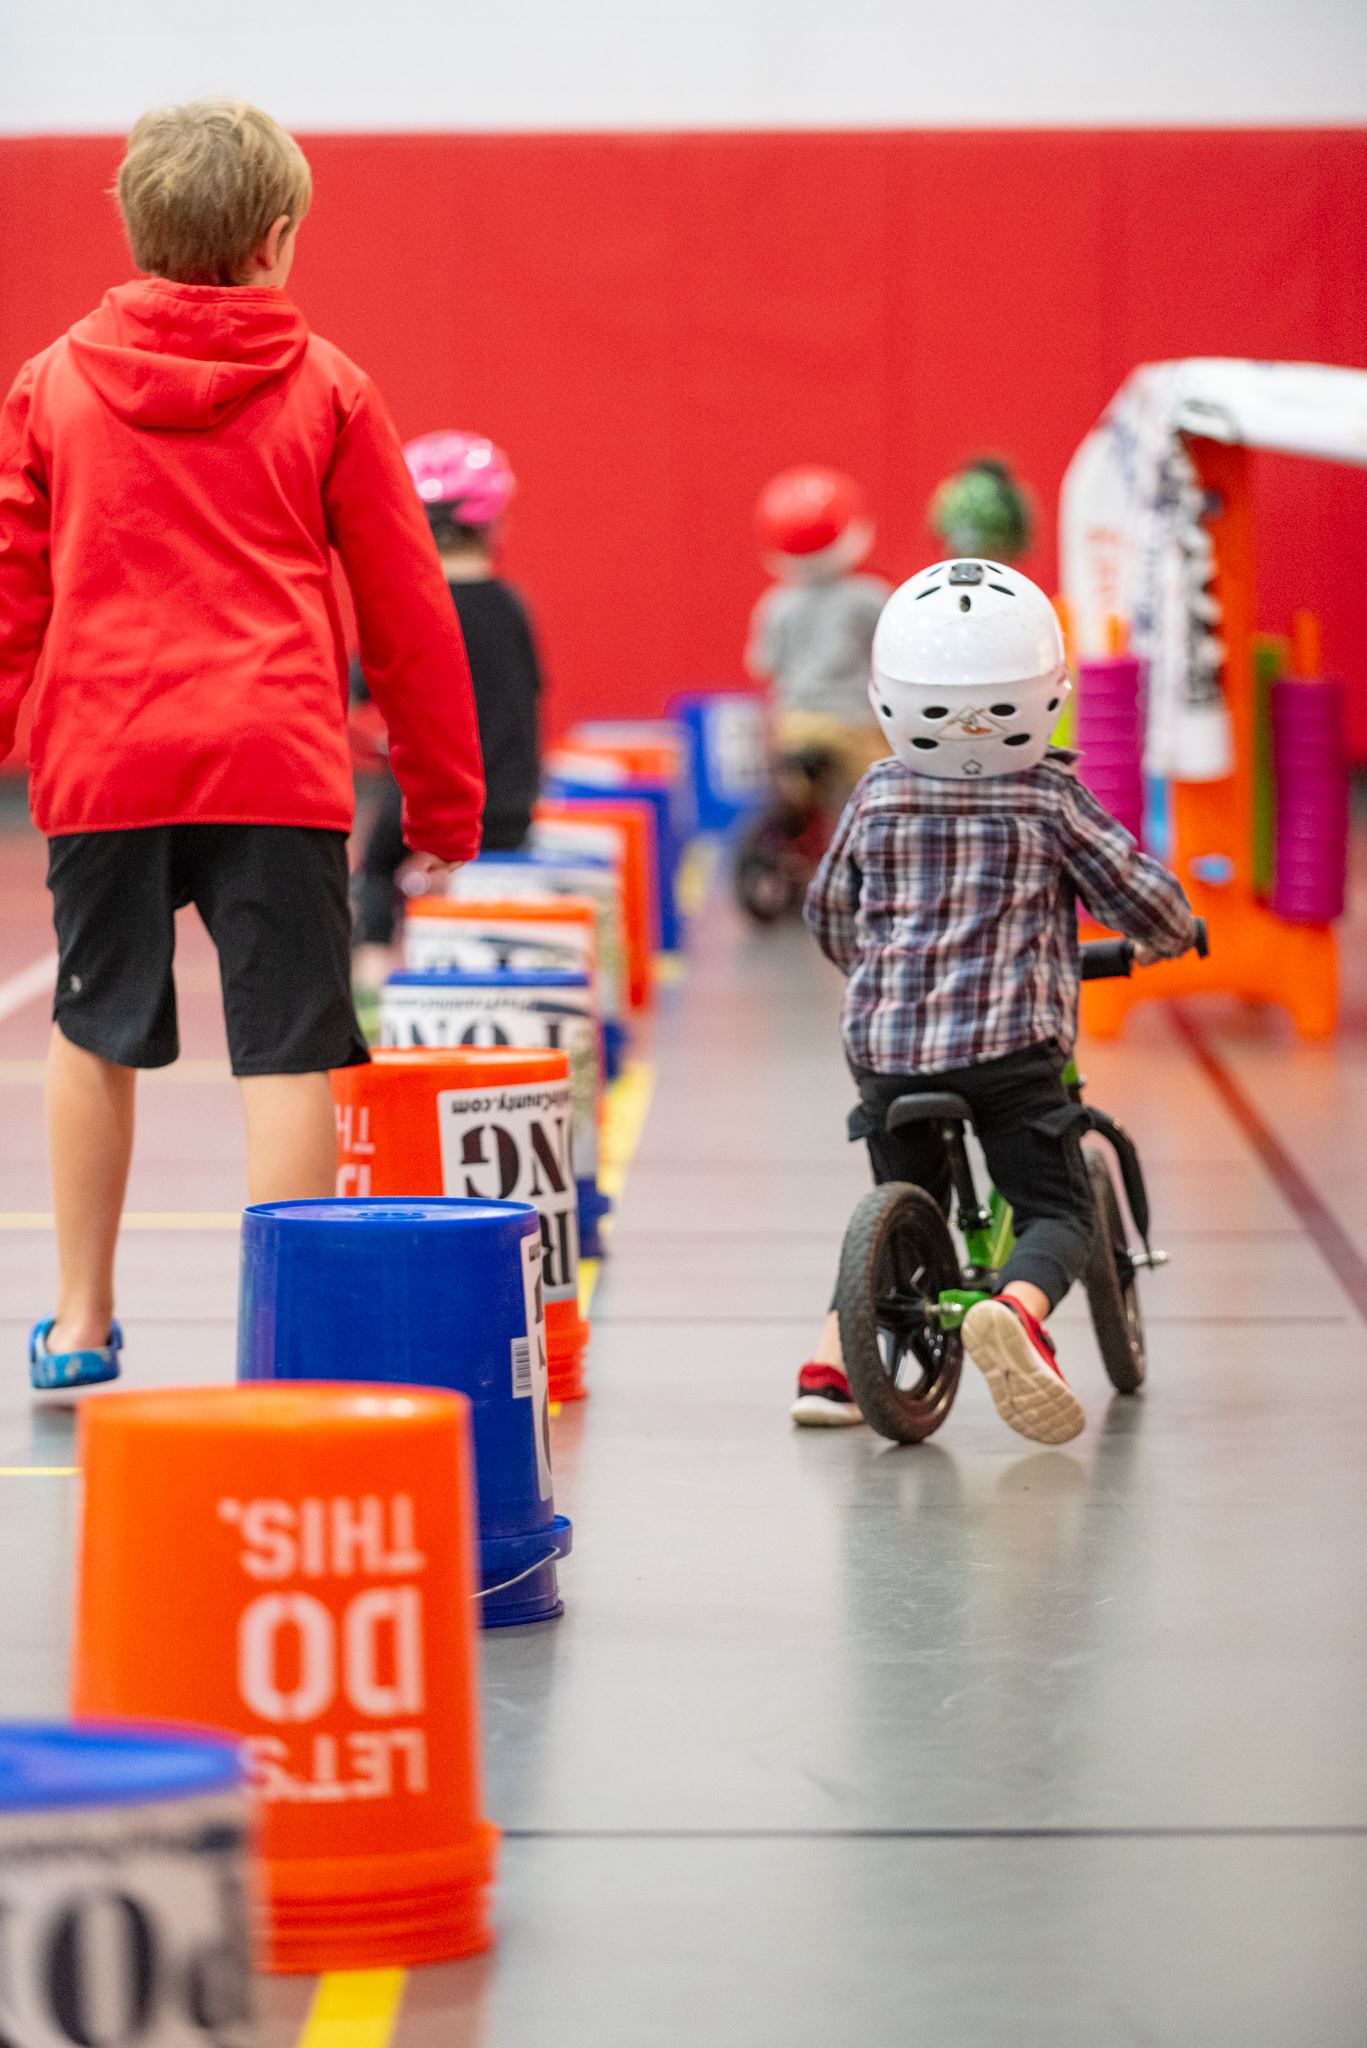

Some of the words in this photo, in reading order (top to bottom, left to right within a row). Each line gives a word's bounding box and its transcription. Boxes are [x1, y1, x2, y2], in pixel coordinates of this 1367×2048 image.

[217, 1494, 426, 1580] THIS.
[237, 1586, 426, 1722] DO
[241, 1730, 430, 1803] LET'S
